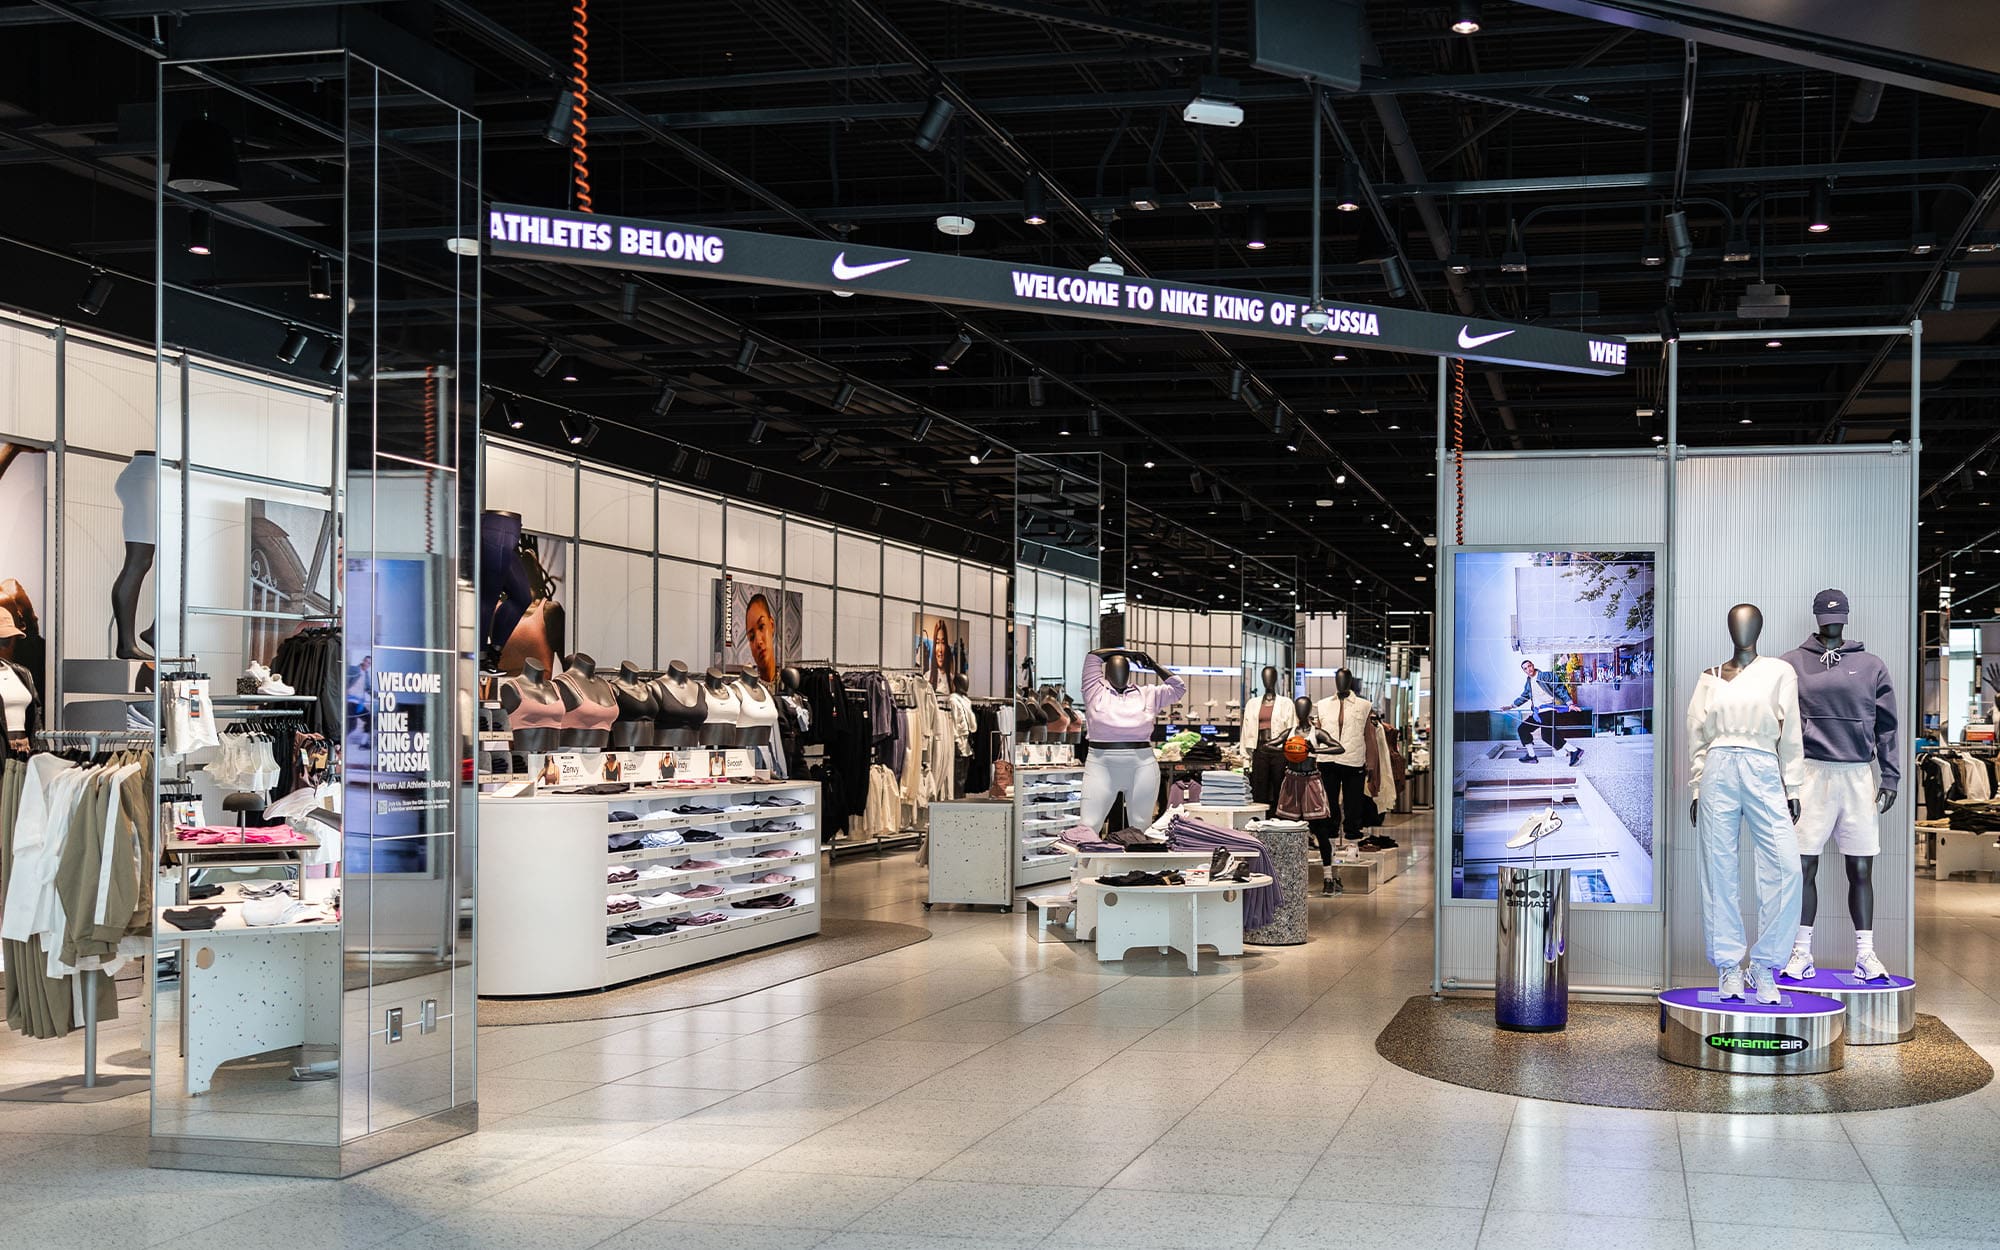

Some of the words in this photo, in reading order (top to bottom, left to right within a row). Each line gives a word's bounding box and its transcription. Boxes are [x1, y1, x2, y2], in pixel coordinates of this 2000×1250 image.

[490, 211, 612, 251] ATHLETES
[620, 226, 724, 264] BELONG
[1012, 271, 1119, 307] WELCOME
[1125, 285, 1154, 310] TO
[1160, 288, 1208, 317] NIKE
[1214, 295, 1264, 323] KING
[1270, 302, 1296, 326] OF
[1301, 305, 1379, 336] USSIA
[1588, 340, 1627, 366] WHE
[377, 671, 441, 693] WELCOME
[378, 692, 396, 712] TO
[378, 711, 408, 732] NIKE
[378, 732, 410, 752] KING
[413, 732, 430, 752] OF
[378, 752, 431, 772] PRUSSIA
[562, 764, 580, 775] Zenvy
[377, 781, 397, 790] Where
[406, 780, 430, 789] Athletes
[431, 780, 450, 789] Belong
